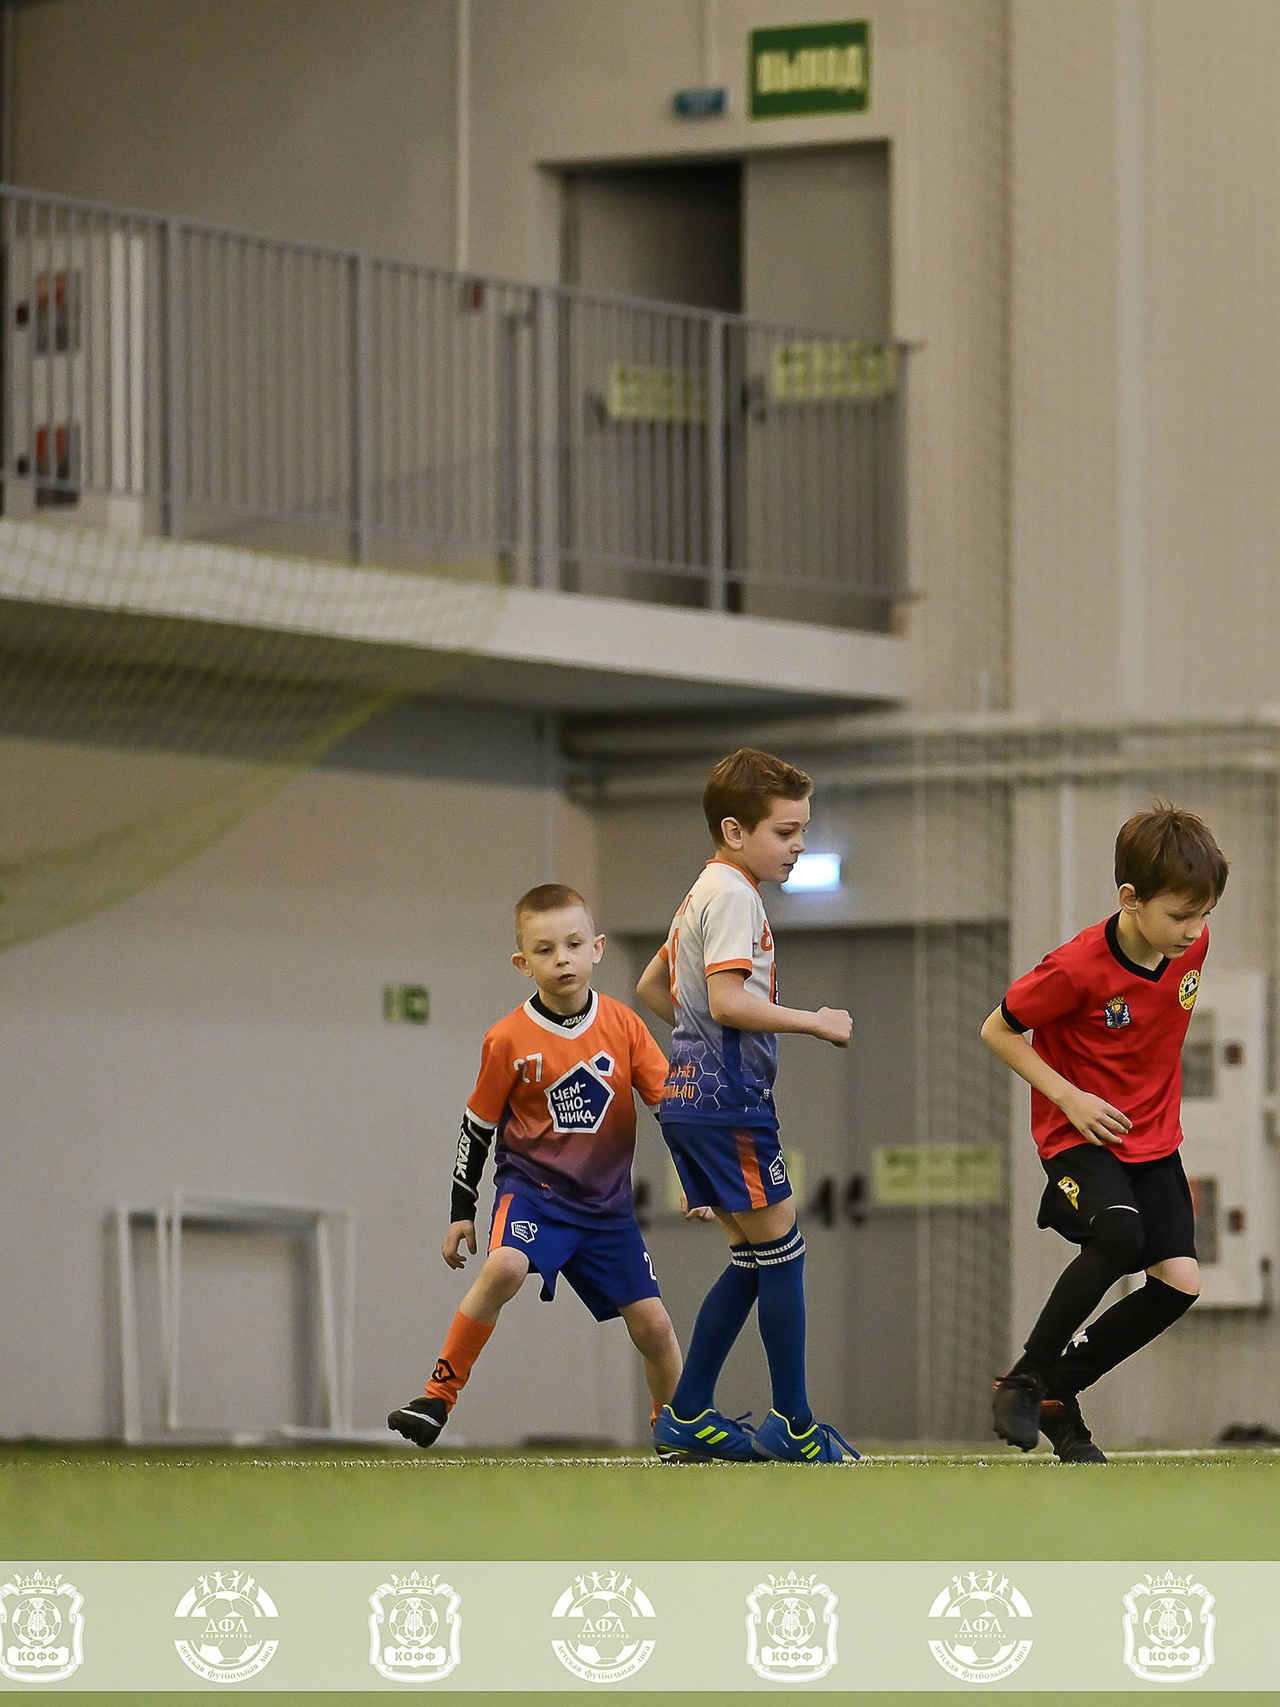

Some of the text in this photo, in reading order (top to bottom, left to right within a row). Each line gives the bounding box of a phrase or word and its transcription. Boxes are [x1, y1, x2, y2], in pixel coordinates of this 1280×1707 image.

[513, 1053, 543, 1084] 27
[552, 1081, 587, 1101] ЧЕМ-
[555, 1096, 592, 1111] ПИО-
[559, 1110, 596, 1124] НИКА
[456, 1127, 471, 1179] ATAK
